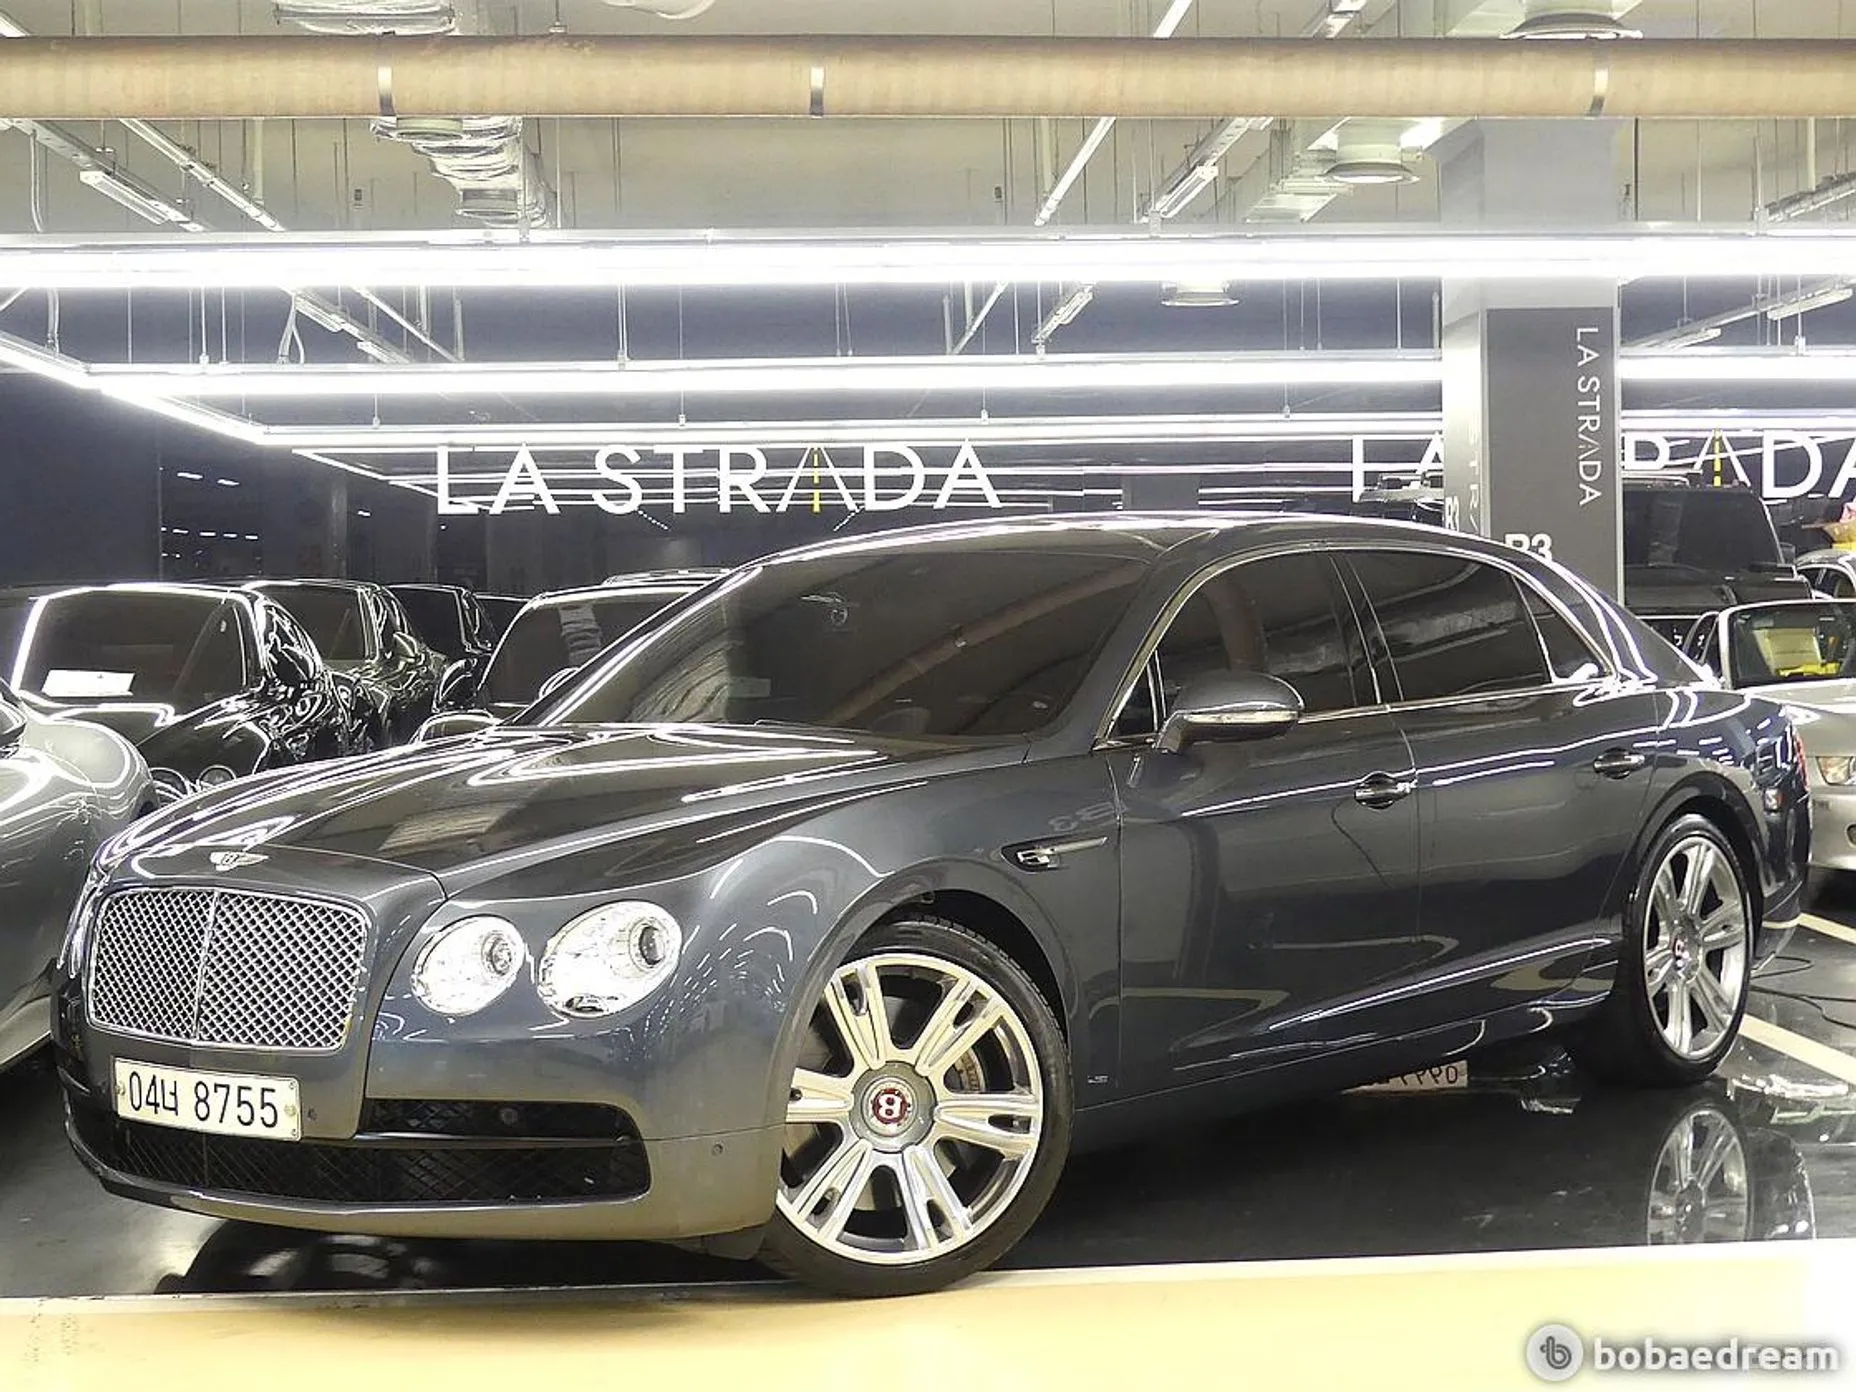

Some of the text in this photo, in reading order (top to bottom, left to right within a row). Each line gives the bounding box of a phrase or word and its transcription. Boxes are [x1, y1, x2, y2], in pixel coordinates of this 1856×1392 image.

[1577, 328, 1602, 506] LA STRADA
[437, 438, 1002, 514] LA STRADA
[194, 1081, 278, 1128] 8755
